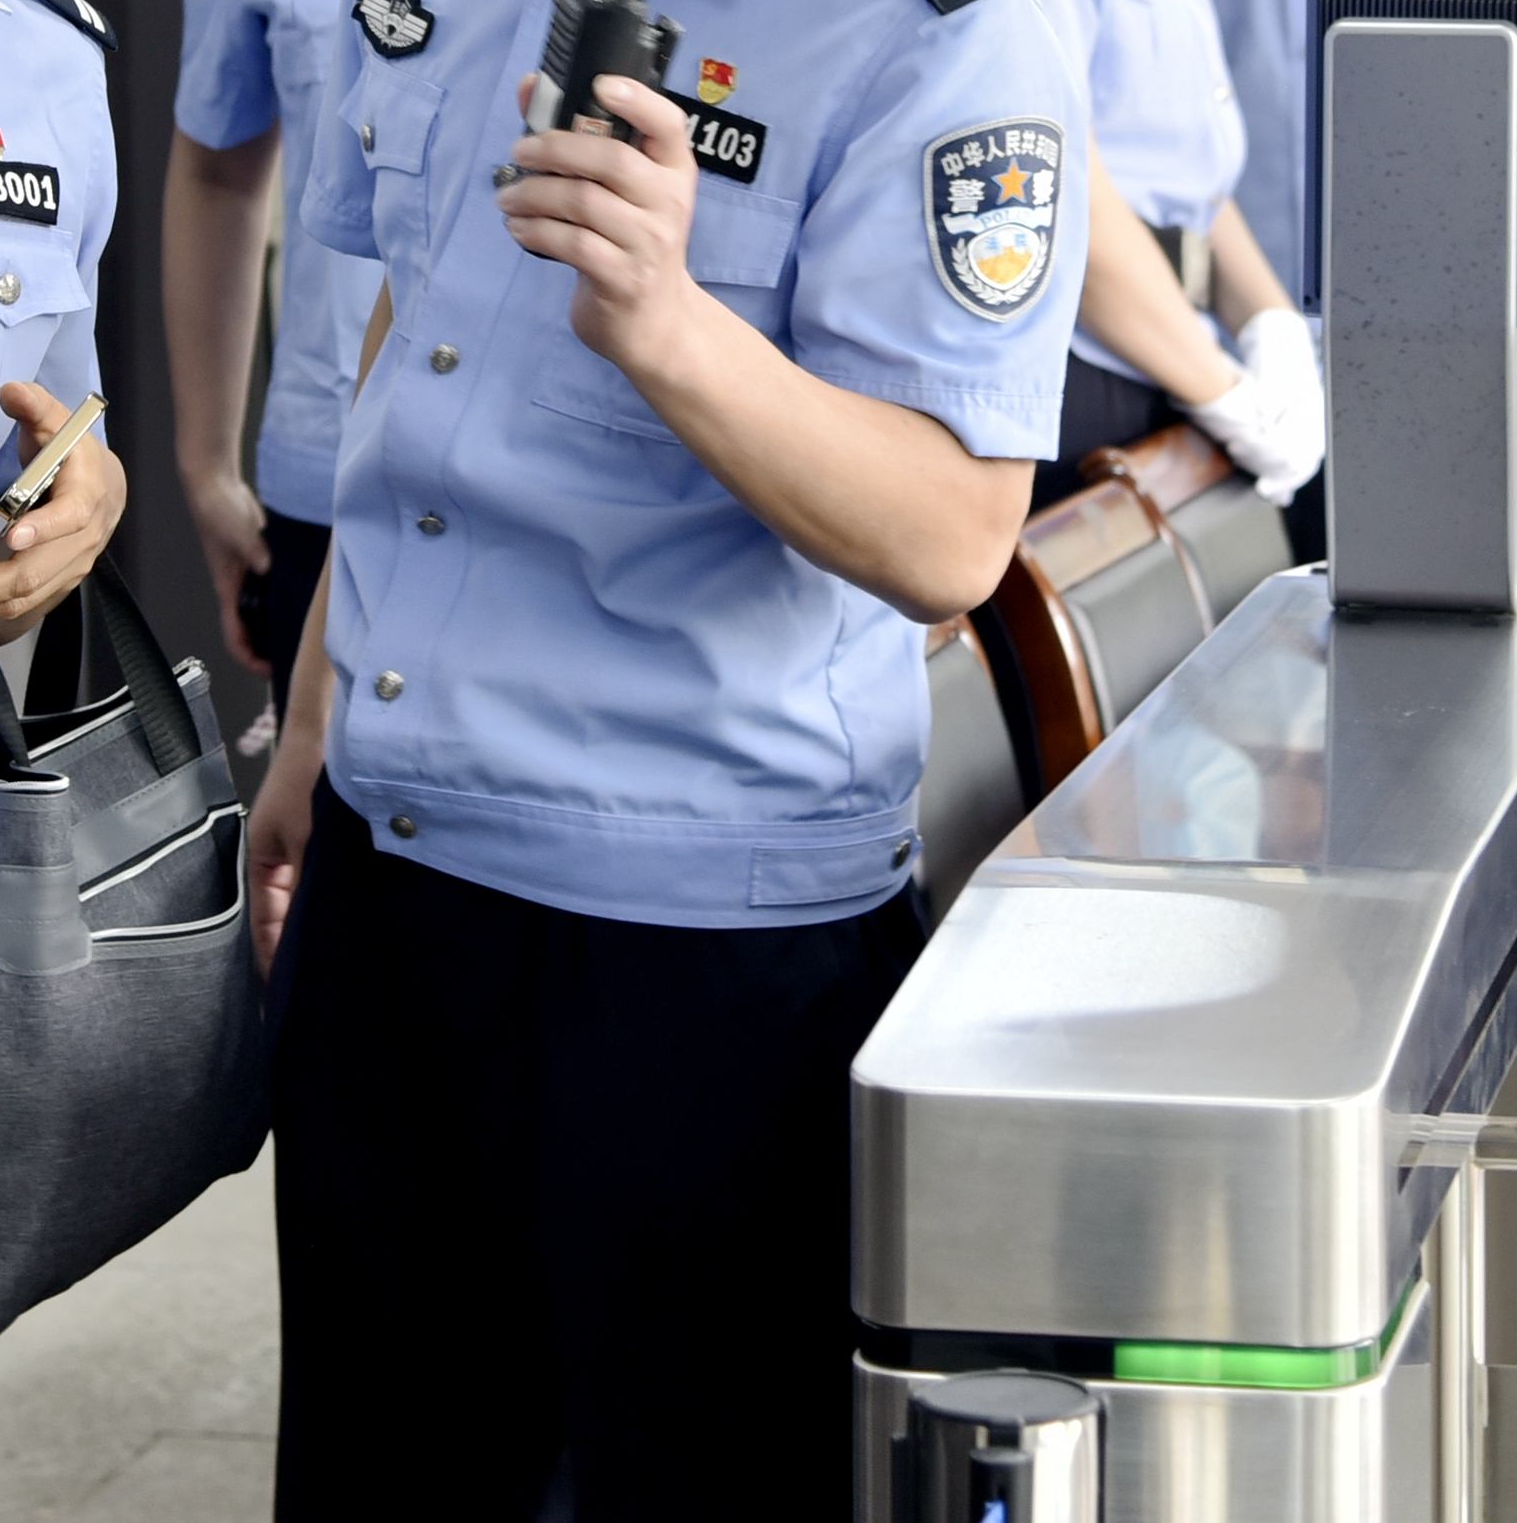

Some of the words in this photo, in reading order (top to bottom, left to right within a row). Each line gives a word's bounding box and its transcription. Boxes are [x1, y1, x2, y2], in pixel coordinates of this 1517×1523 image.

[941, 129, 1059, 177] 中华人民共和国
